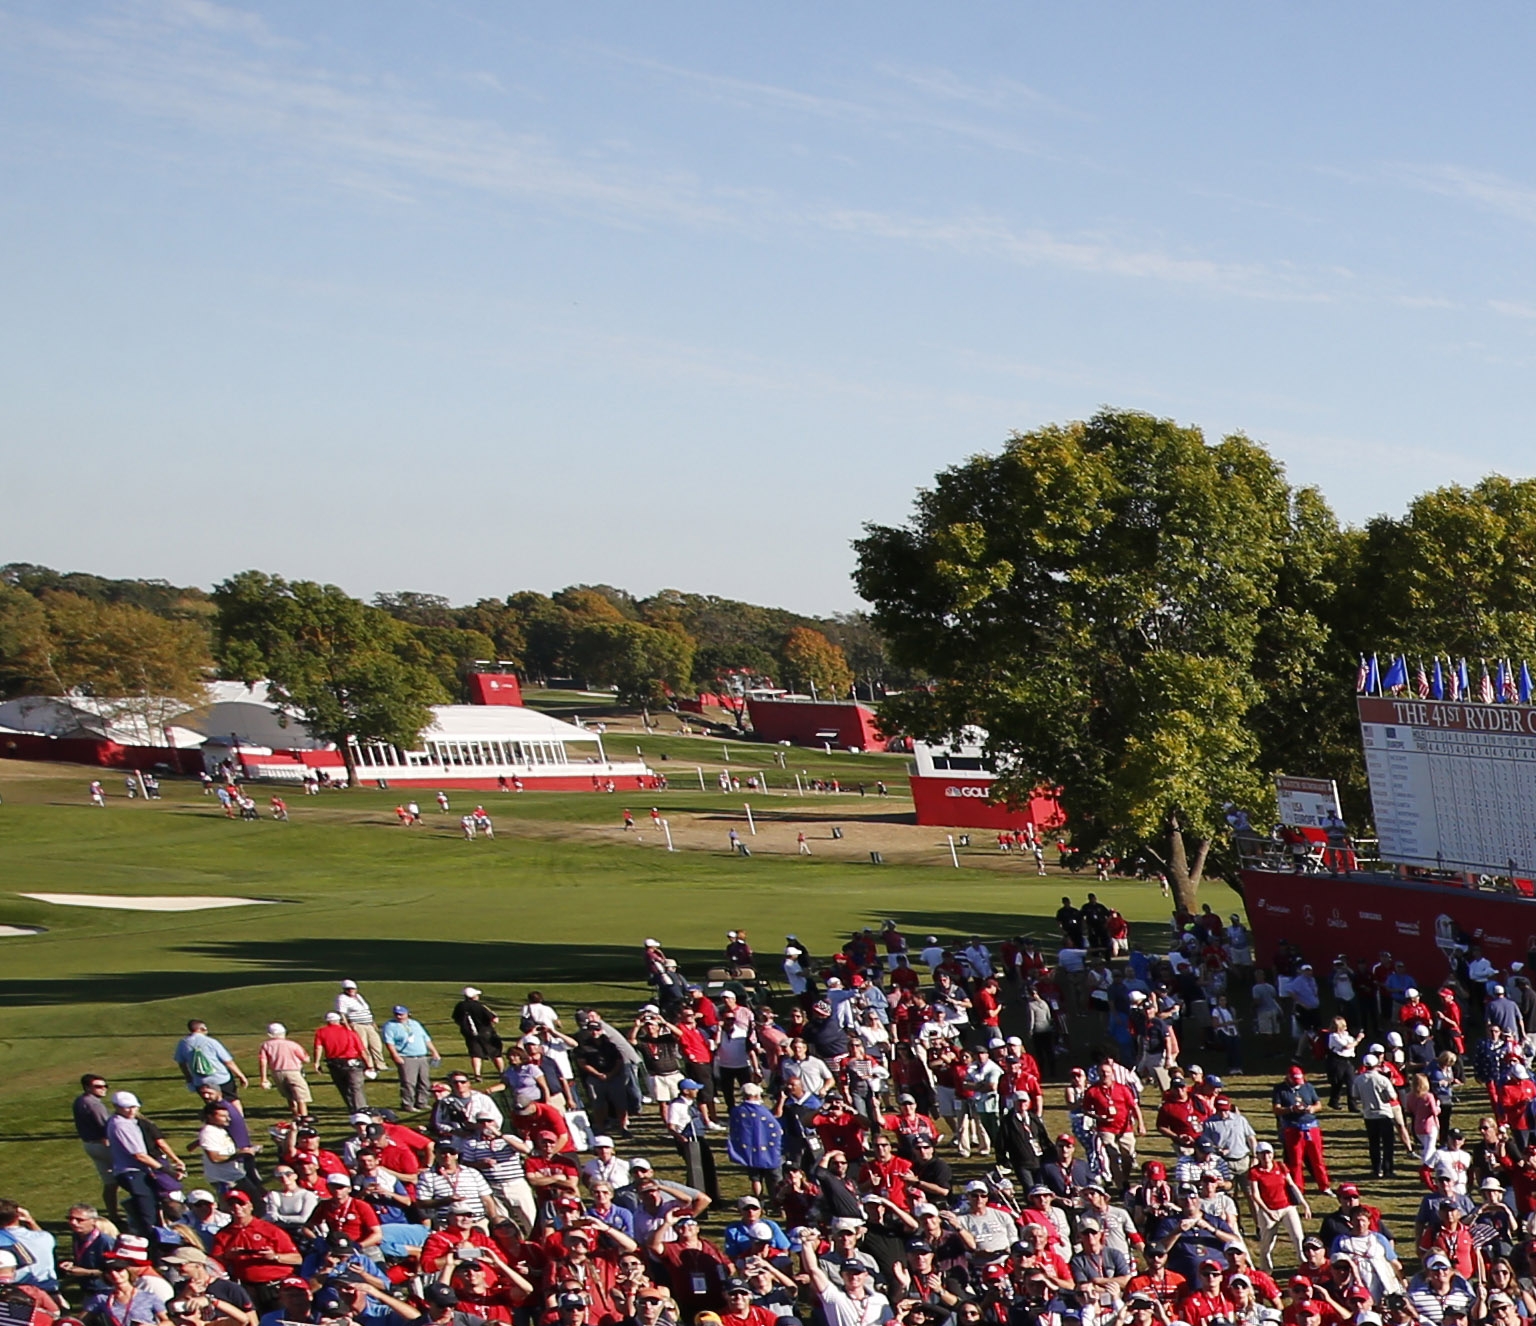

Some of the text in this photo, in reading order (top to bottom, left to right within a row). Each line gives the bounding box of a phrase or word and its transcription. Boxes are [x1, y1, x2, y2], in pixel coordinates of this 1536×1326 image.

[1392, 702, 1429, 726] THE
[1432, 705, 1460, 728] 41ST
[1465, 707, 1525, 733] RYDER
[961, 786, 990, 798] GOLF
